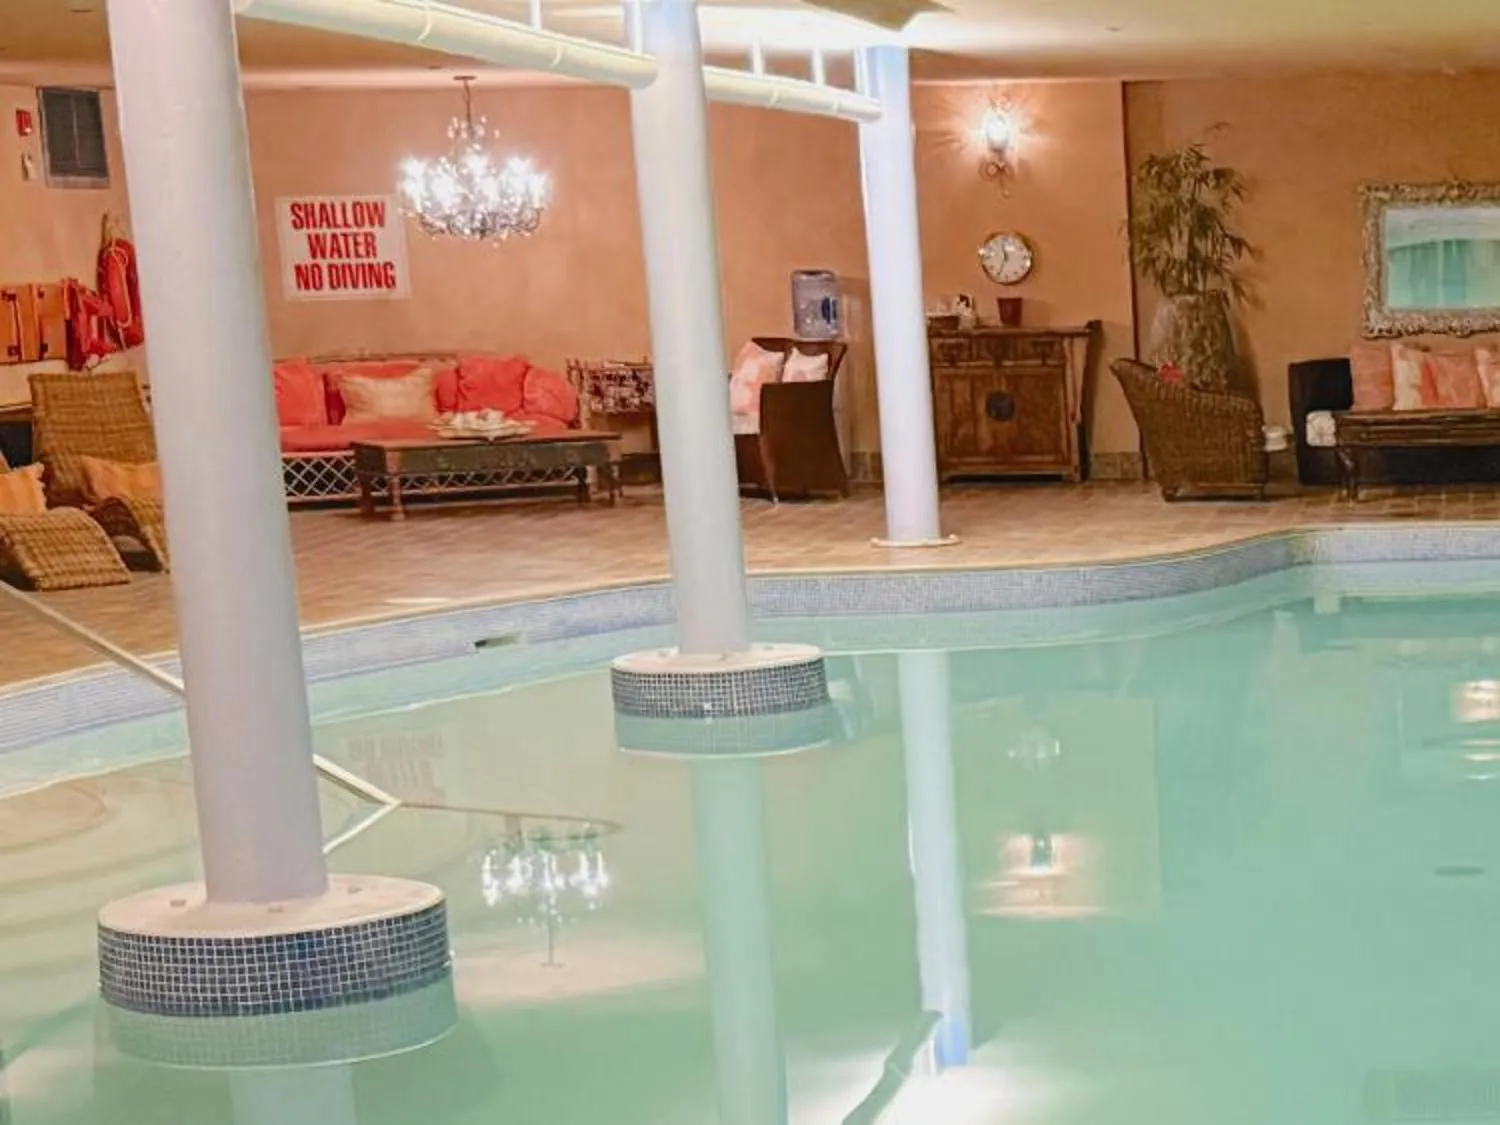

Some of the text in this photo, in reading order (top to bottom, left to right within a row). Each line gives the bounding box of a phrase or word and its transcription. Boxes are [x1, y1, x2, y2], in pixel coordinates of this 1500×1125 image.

[290, 201, 385, 229] SHALLOW
[307, 231, 377, 259] WATER
[294, 261, 396, 291] NO DIVING
